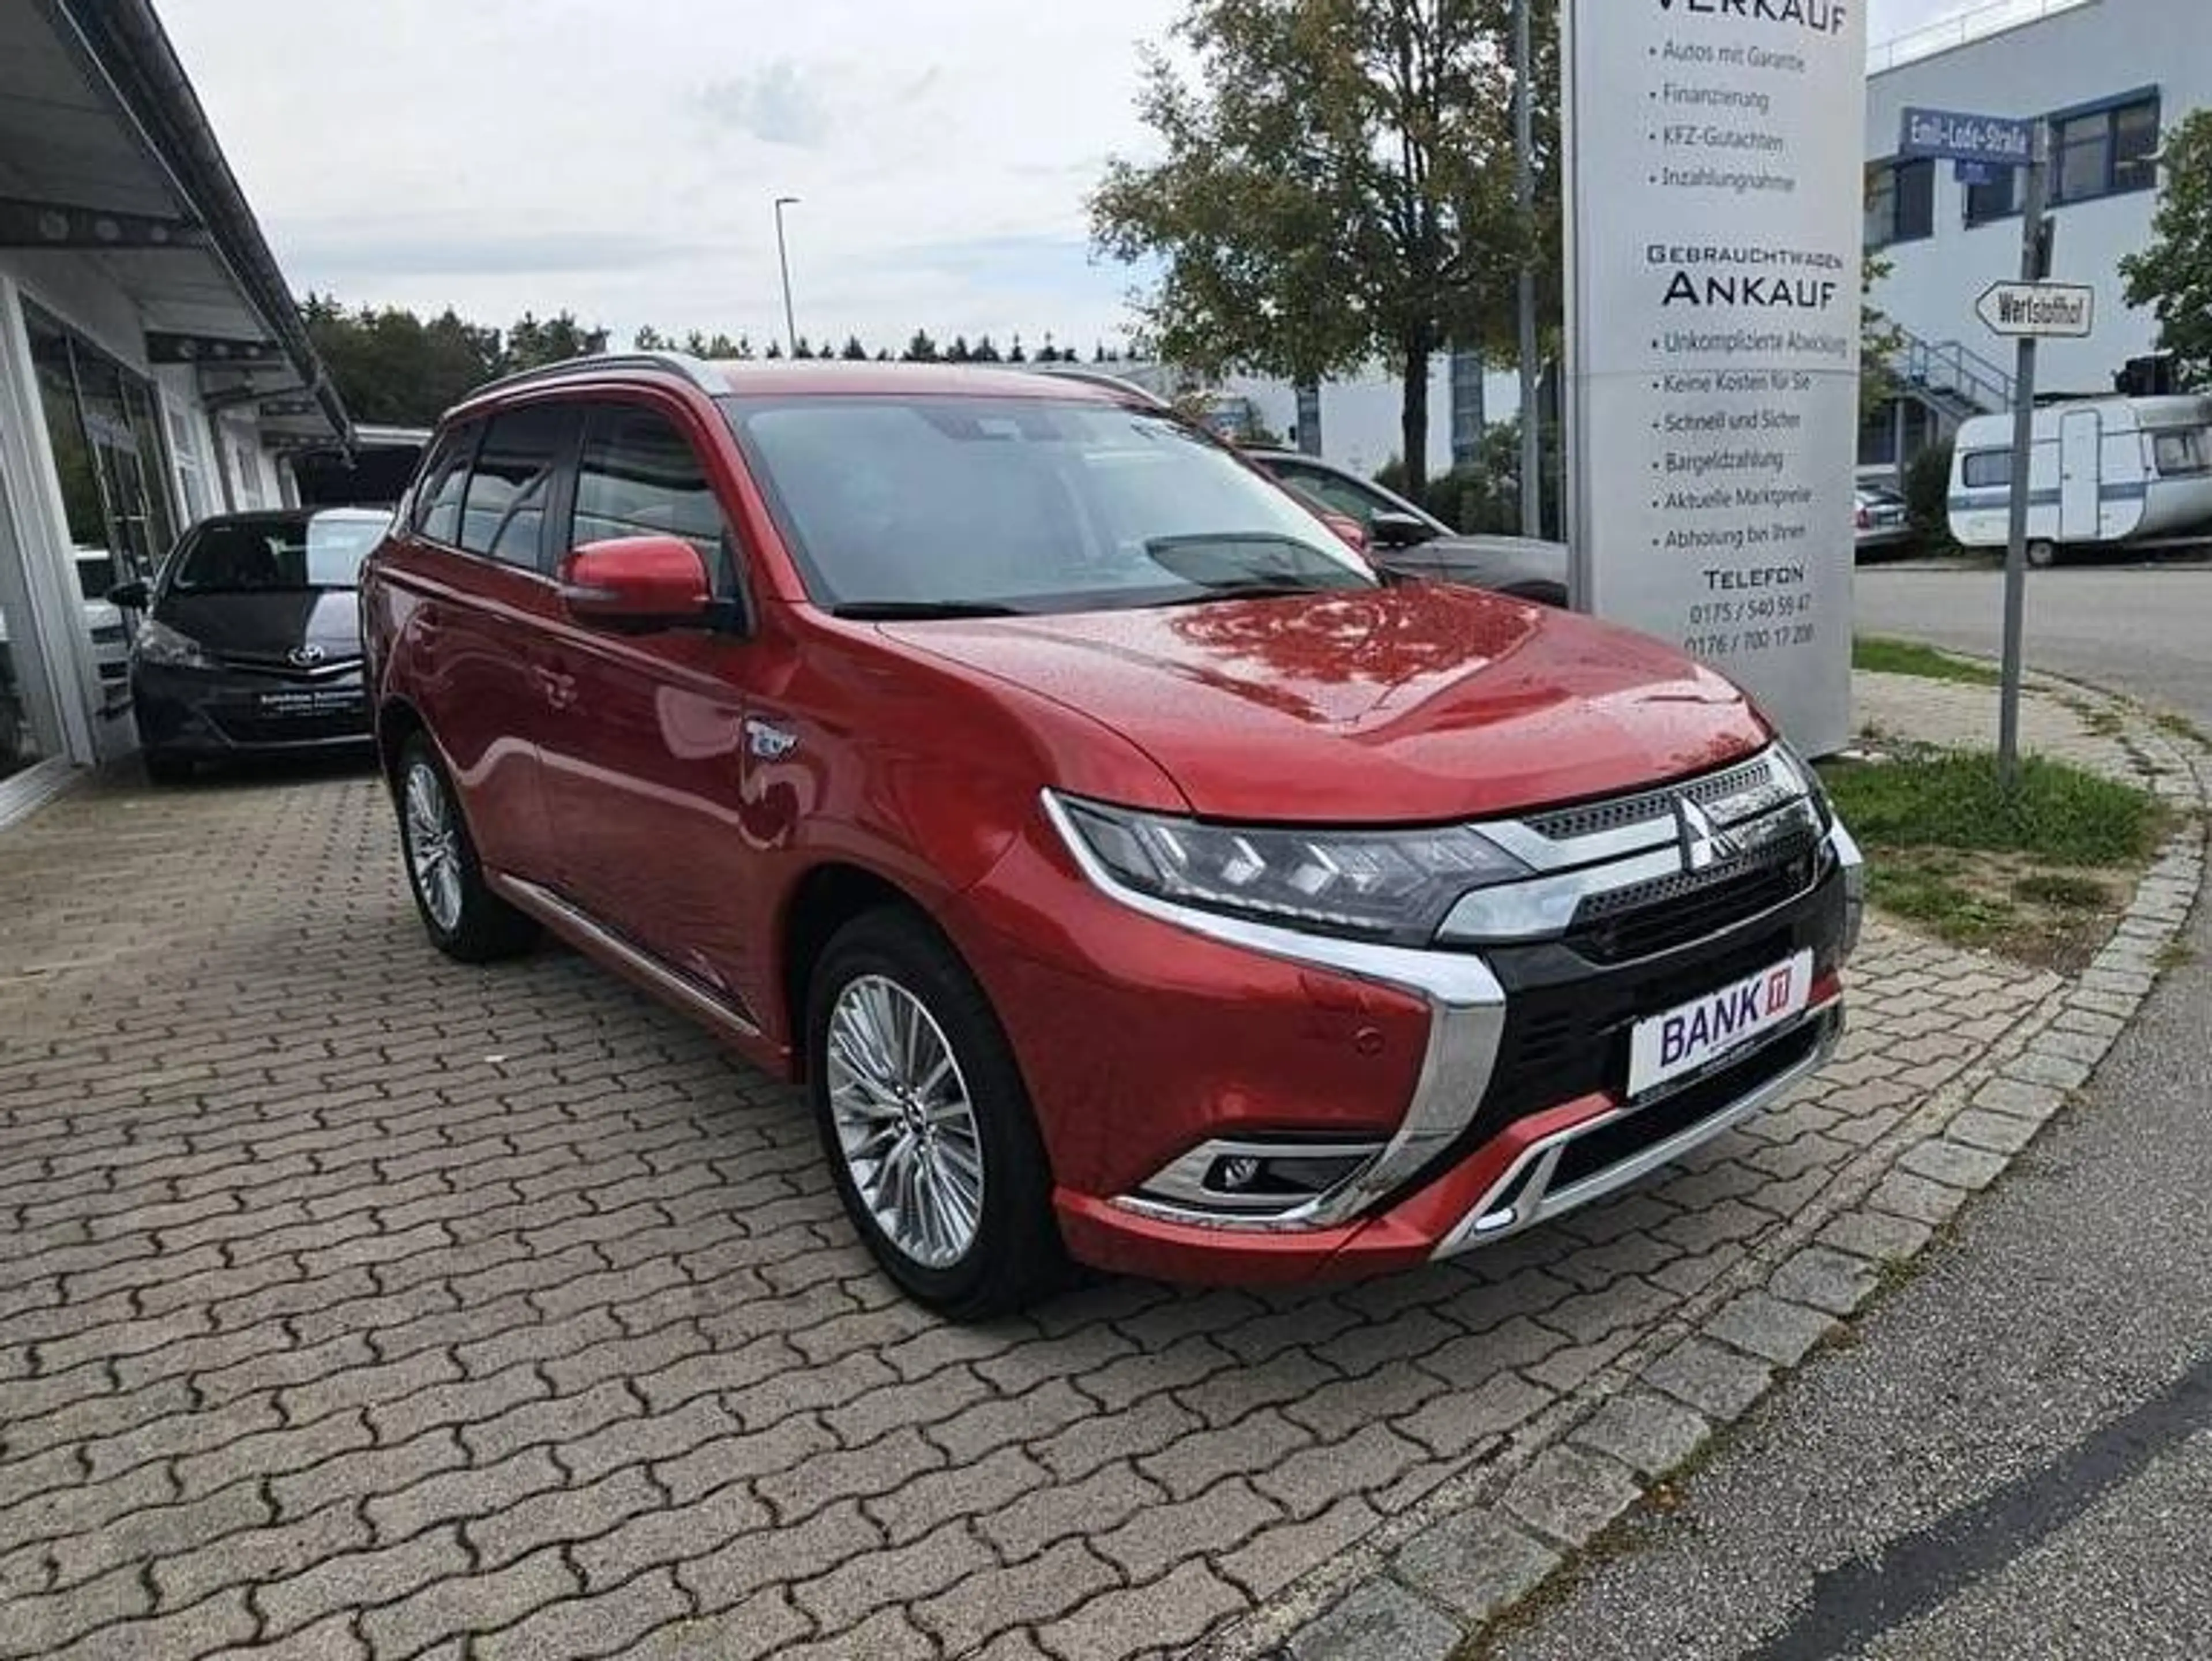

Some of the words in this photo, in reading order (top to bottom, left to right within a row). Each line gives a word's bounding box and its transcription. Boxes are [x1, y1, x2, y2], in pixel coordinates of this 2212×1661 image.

[1661, 270, 1837, 310] ANKAUF
[1703, 565, 1804, 589] TELEFON
[1690, 603, 1730, 623] 0175
[1661, 979, 1762, 1067] BANK
